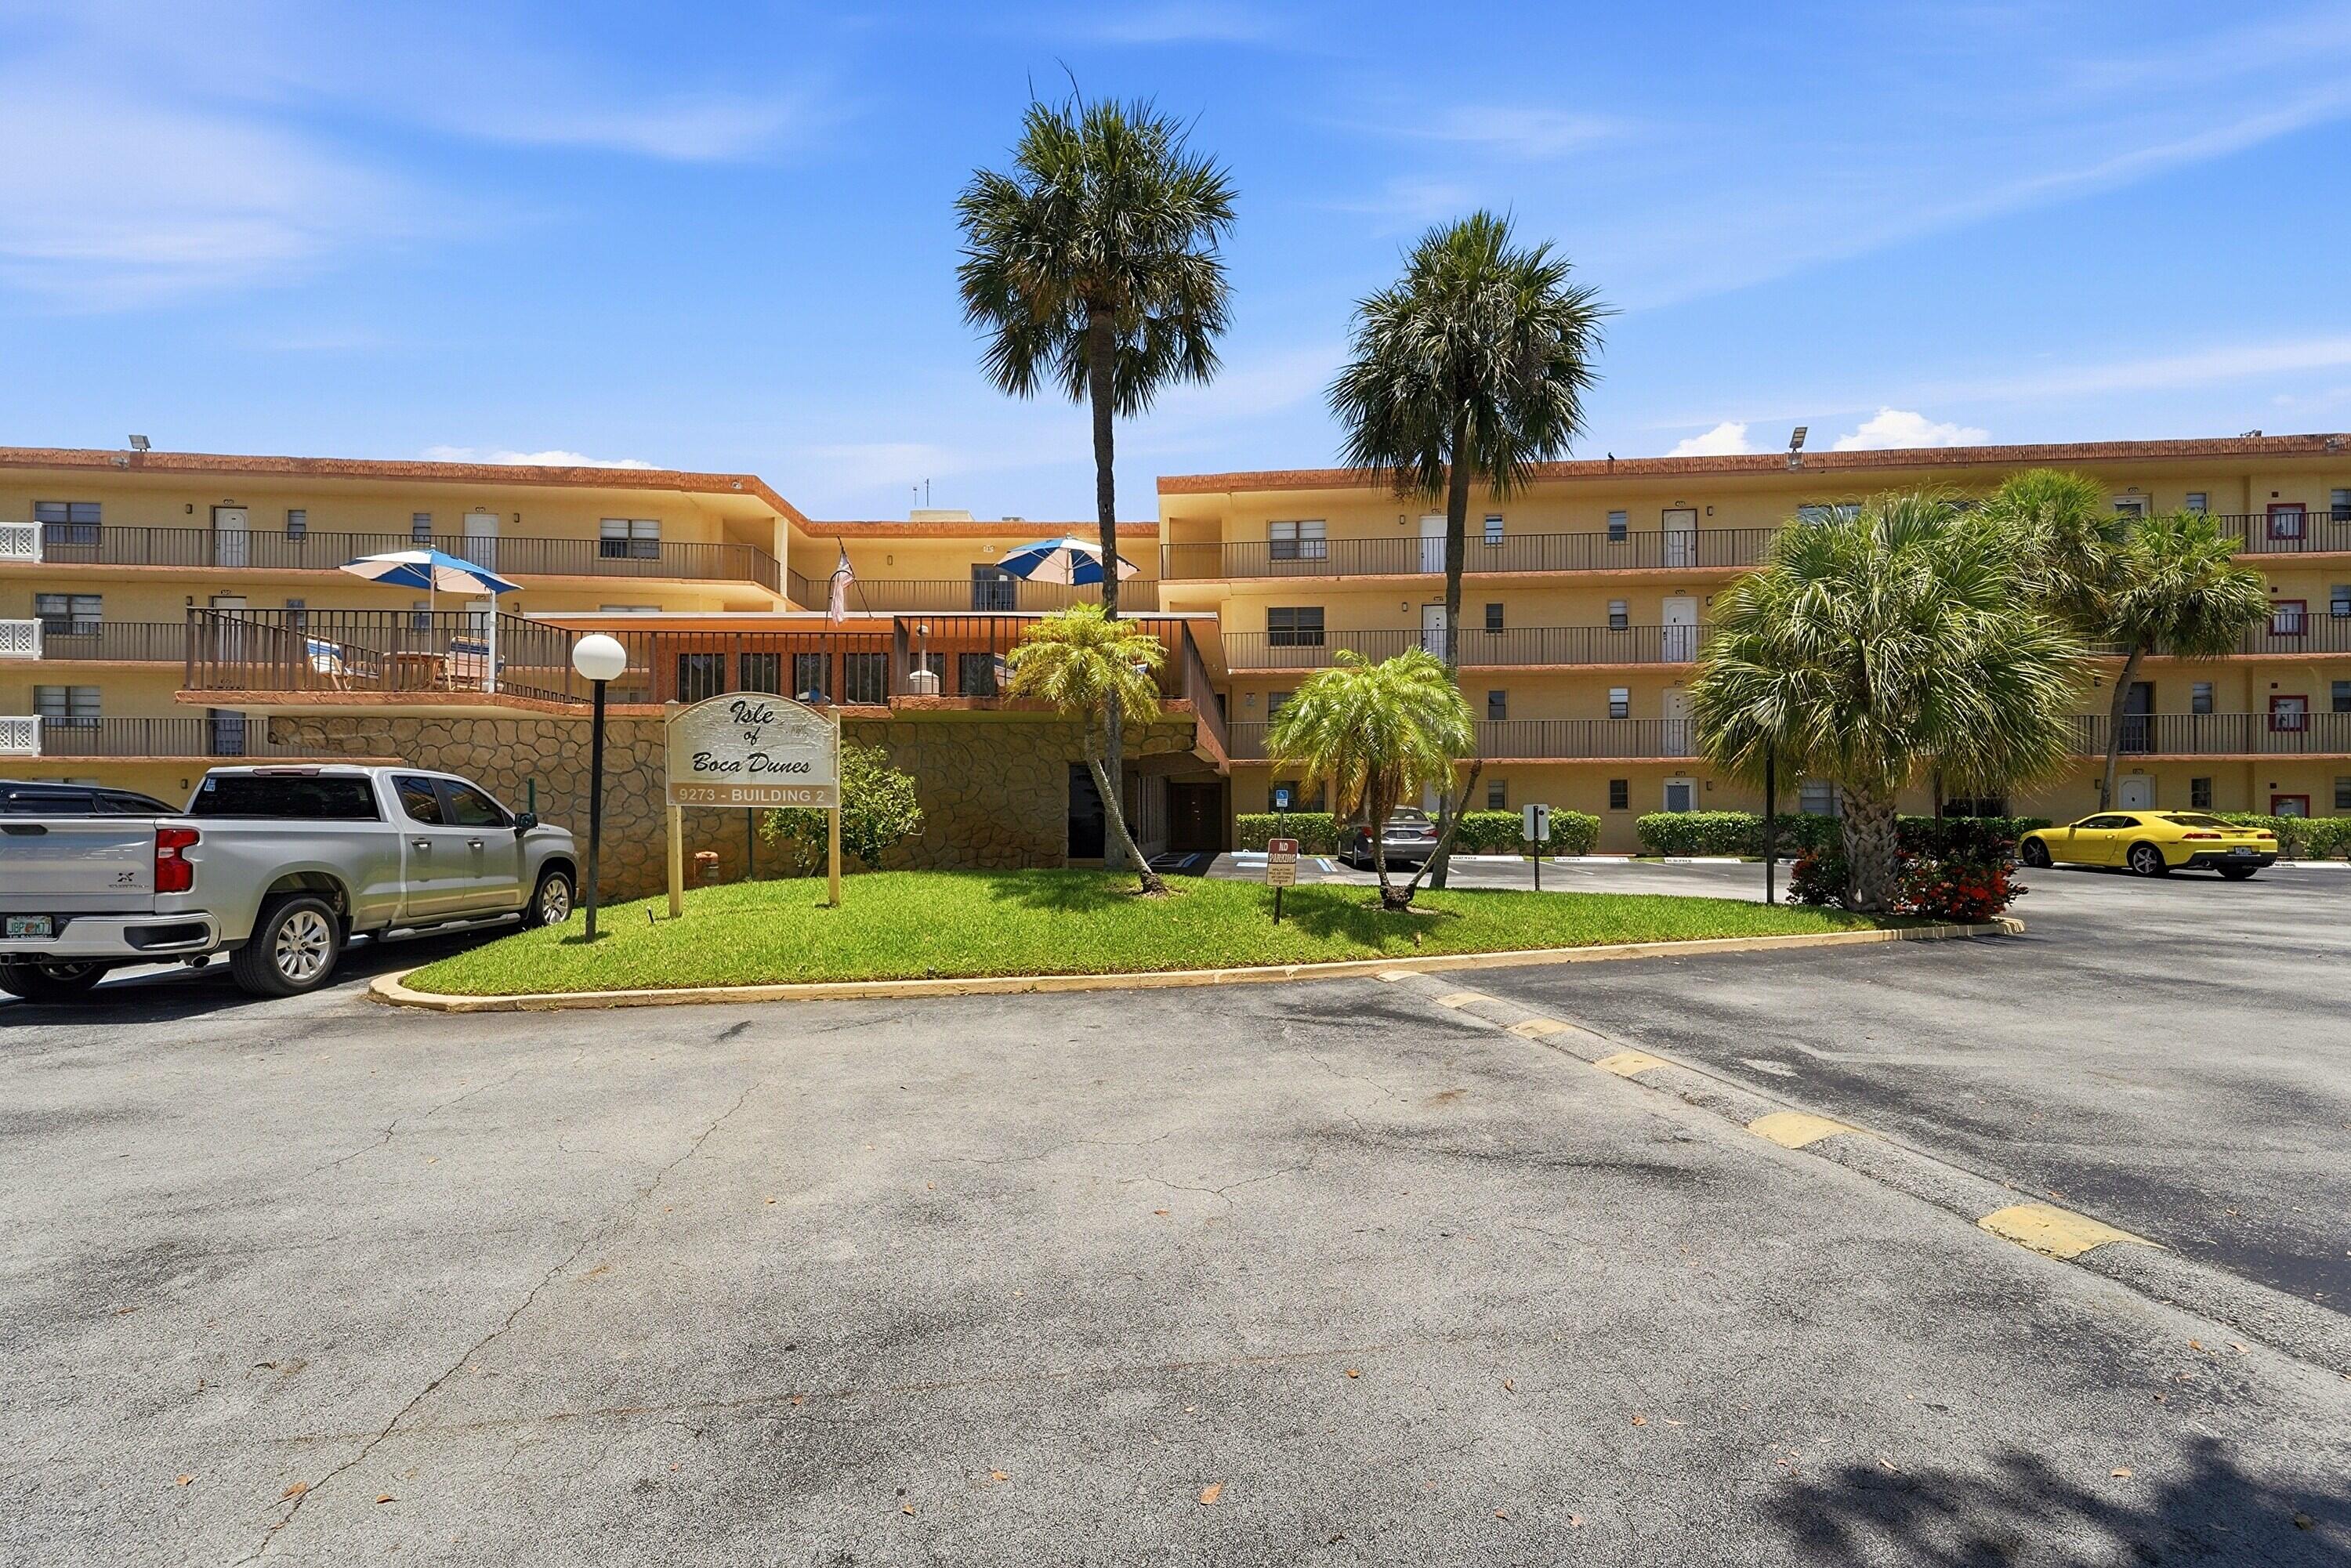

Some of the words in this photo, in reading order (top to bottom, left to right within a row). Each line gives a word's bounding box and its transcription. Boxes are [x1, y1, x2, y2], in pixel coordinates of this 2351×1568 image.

[730, 701, 774, 724] Isle
[744, 727, 759, 745] of
[692, 751, 742, 772] Boca
[747, 752, 811, 773] Dunes
[679, 789, 715, 801] 9273
[732, 790, 811, 802] BUILDING
[817, 791, 824, 802] 2
[1279, 842, 1288, 851] NO
[1269, 853, 1295, 863] PARKING
